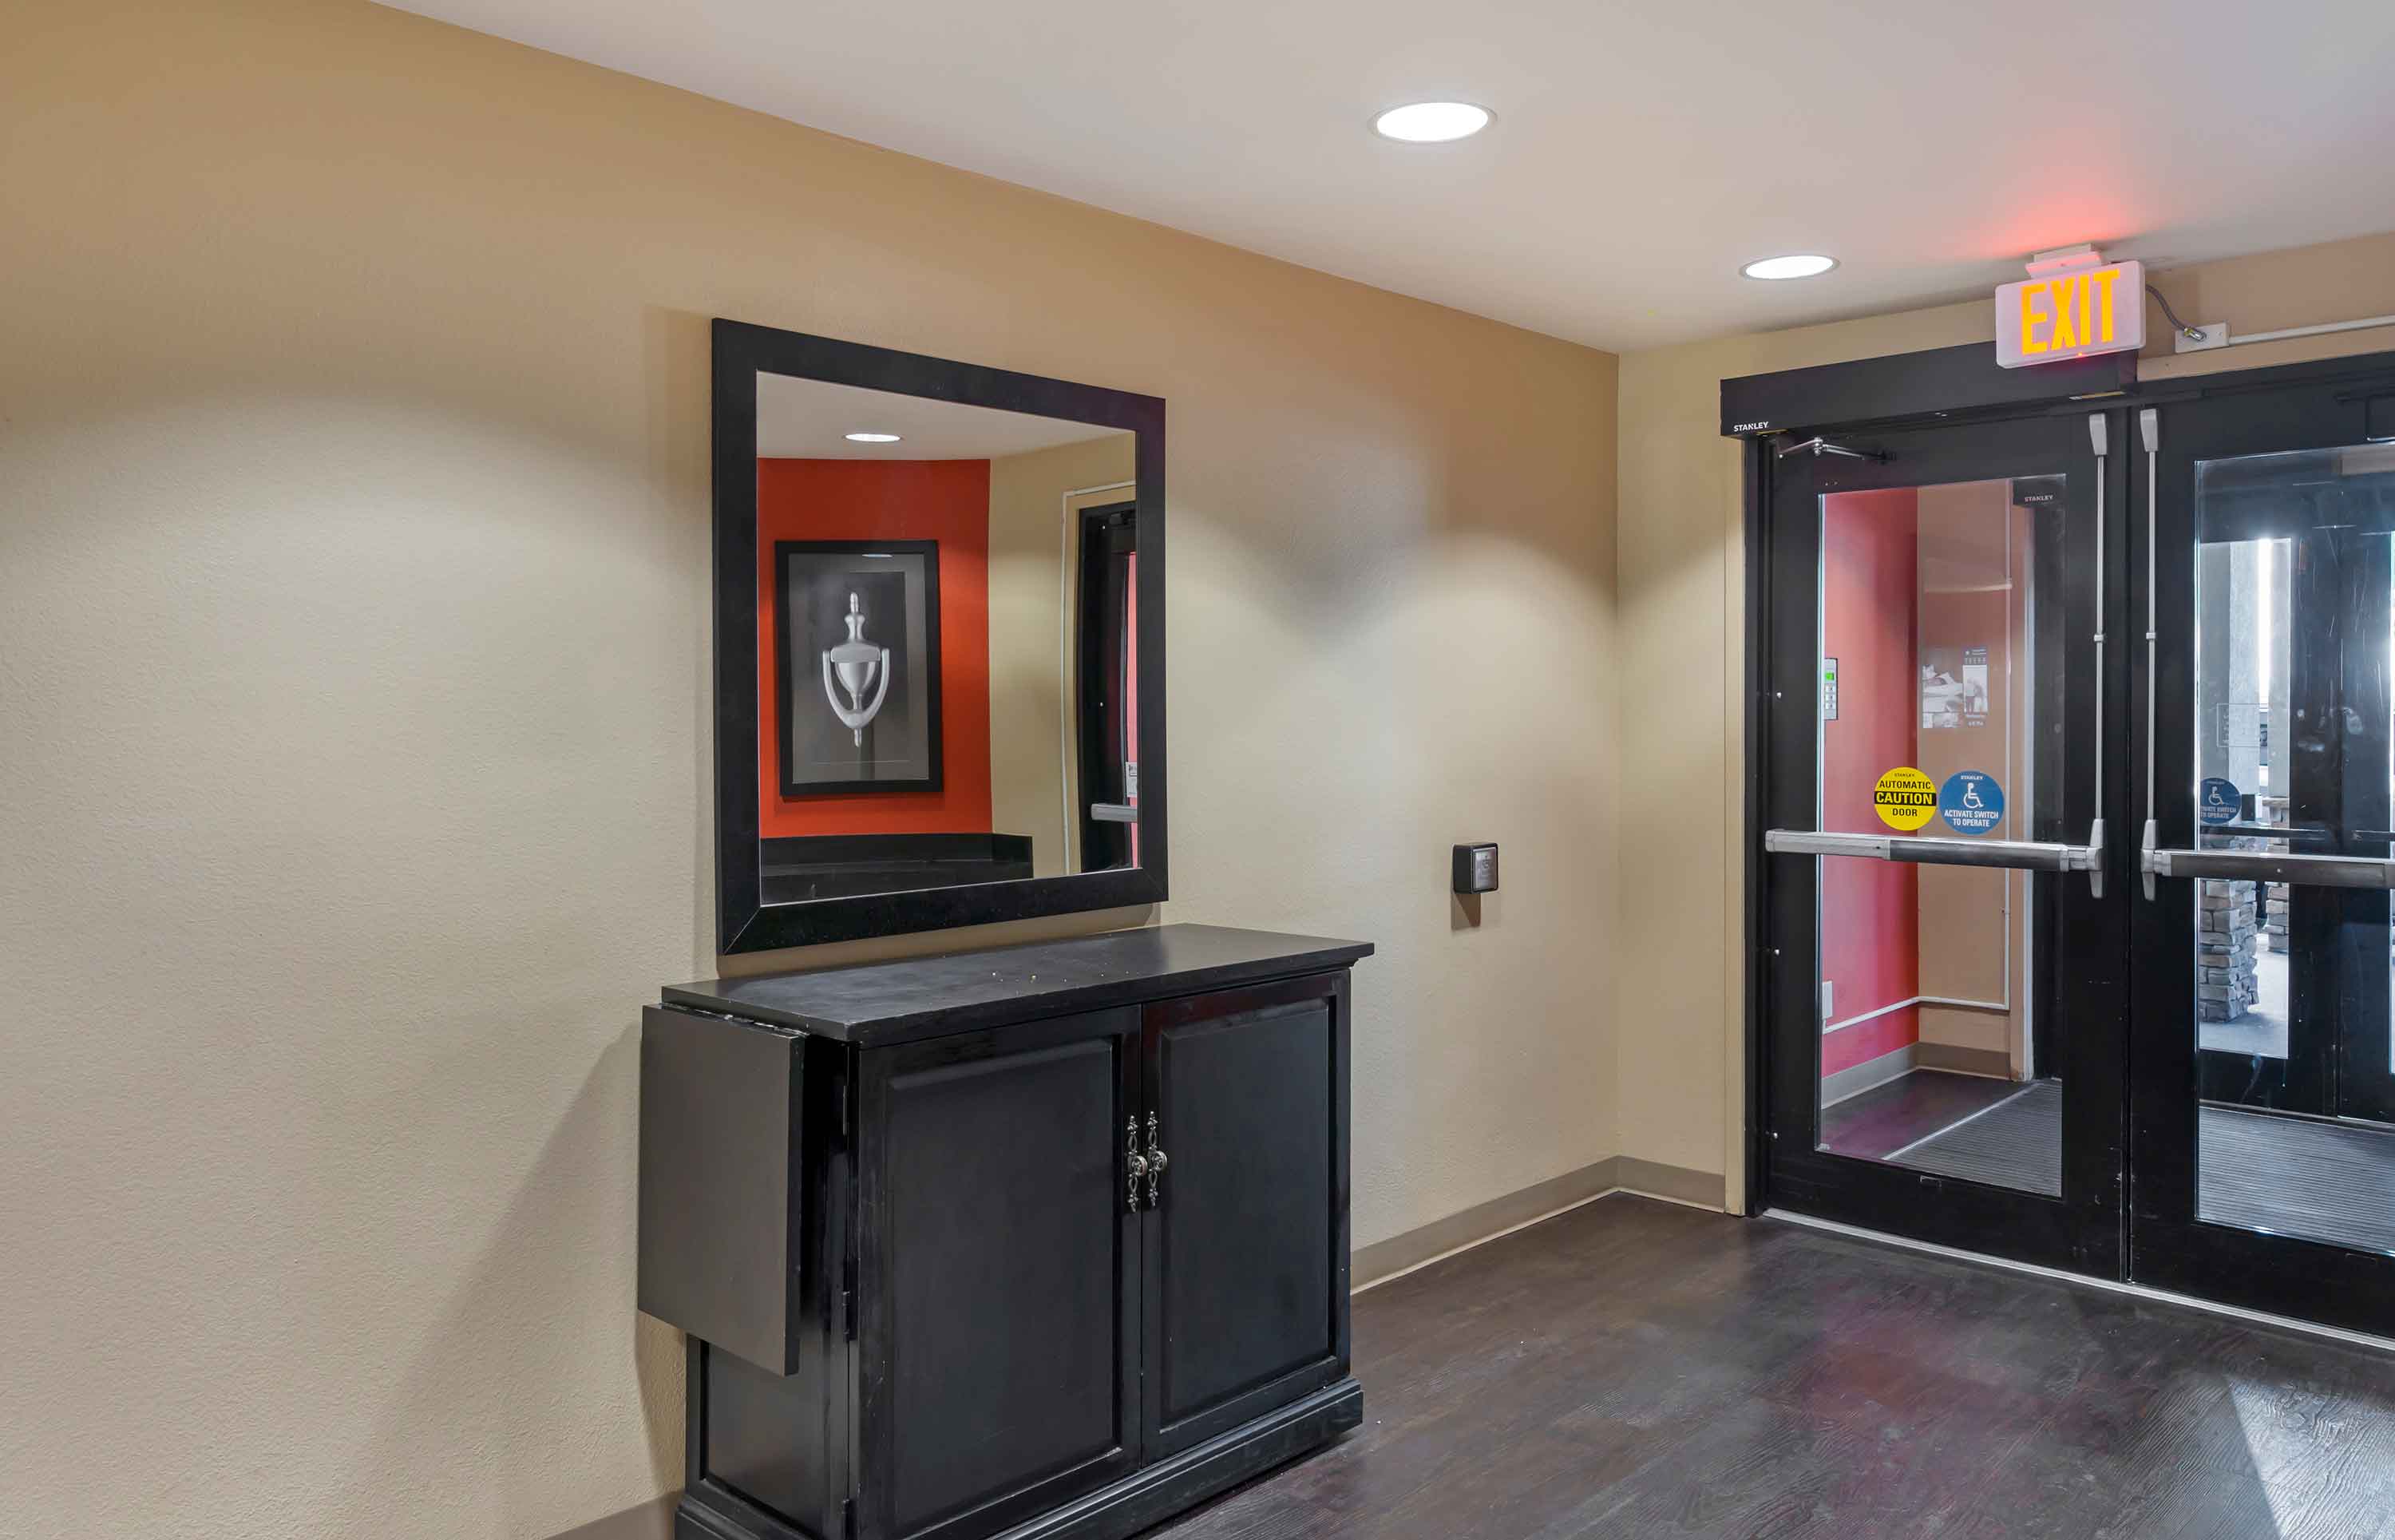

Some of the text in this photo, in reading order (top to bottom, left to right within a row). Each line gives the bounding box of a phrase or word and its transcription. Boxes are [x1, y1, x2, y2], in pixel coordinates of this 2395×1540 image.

[2021, 268, 2120, 355] EXIT
[1733, 421, 1769, 432] STANLEY
[1879, 780, 1931, 790] AUTOMATIC
[1876, 792, 1933, 805] CAUTION
[1892, 808, 1918, 817] DOOR
[1944, 810, 1999, 819] ACTIVATE SWITCH
[1953, 818, 1990, 827] TO OPERATE
